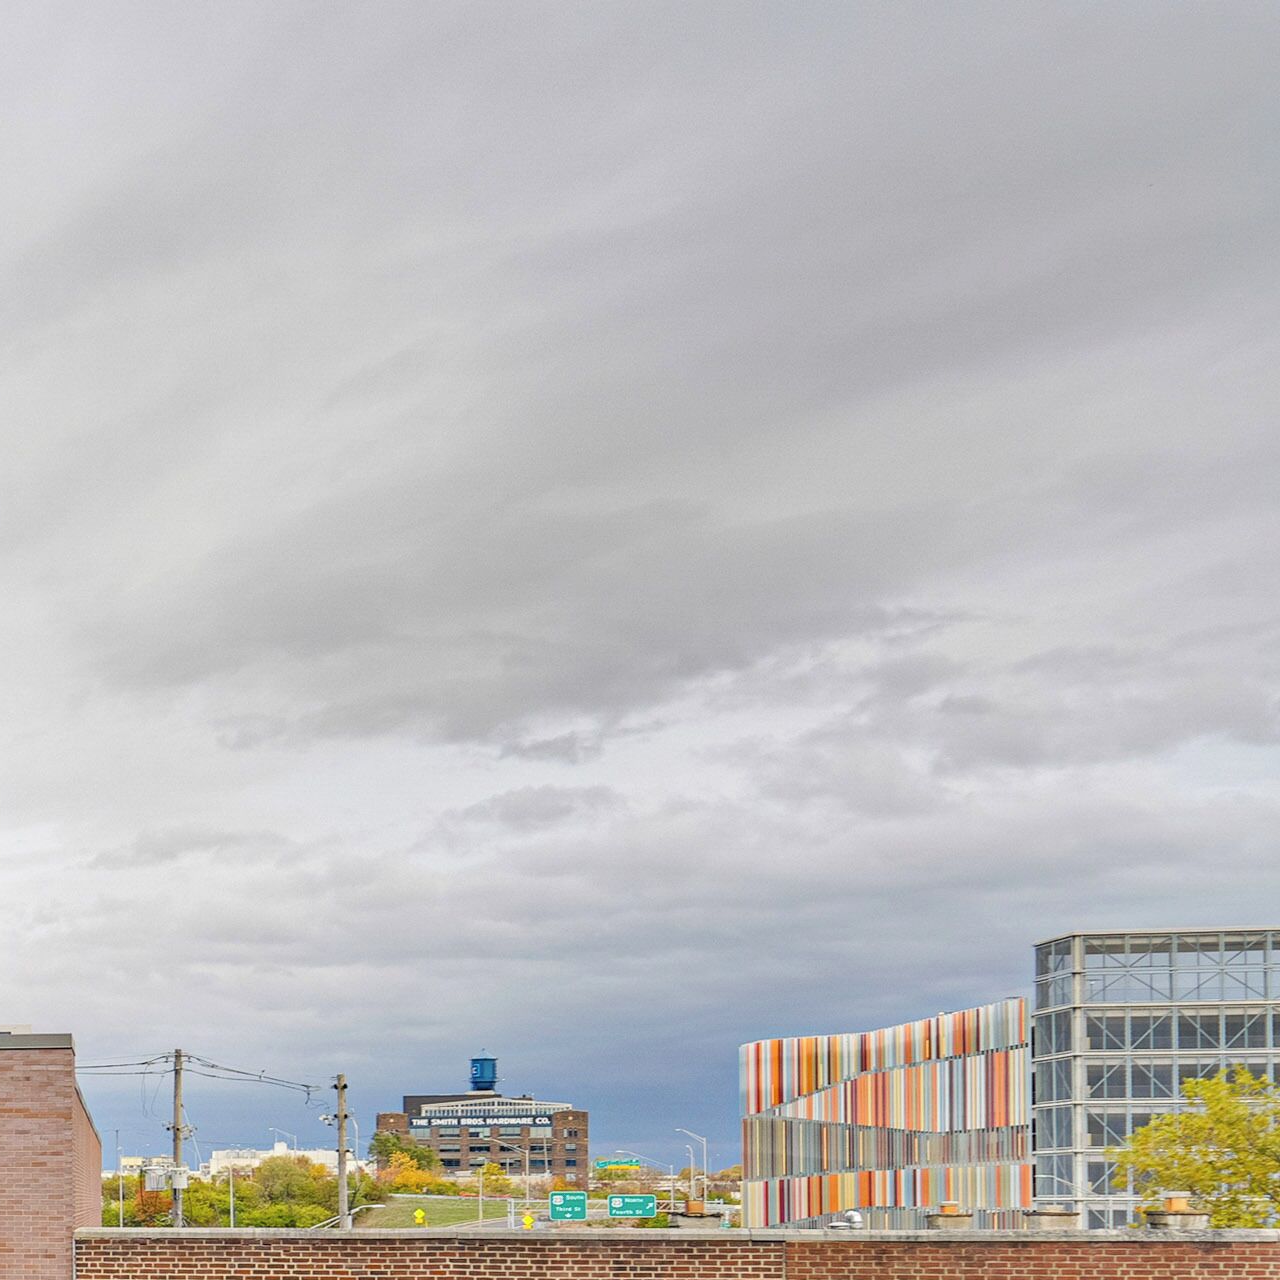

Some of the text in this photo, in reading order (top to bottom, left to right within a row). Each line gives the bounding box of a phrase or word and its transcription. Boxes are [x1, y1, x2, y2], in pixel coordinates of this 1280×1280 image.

[411, 1118, 429, 1126] THE
[430, 1118, 458, 1126] SMITH
[486, 1117, 533, 1125] HARDWARE
